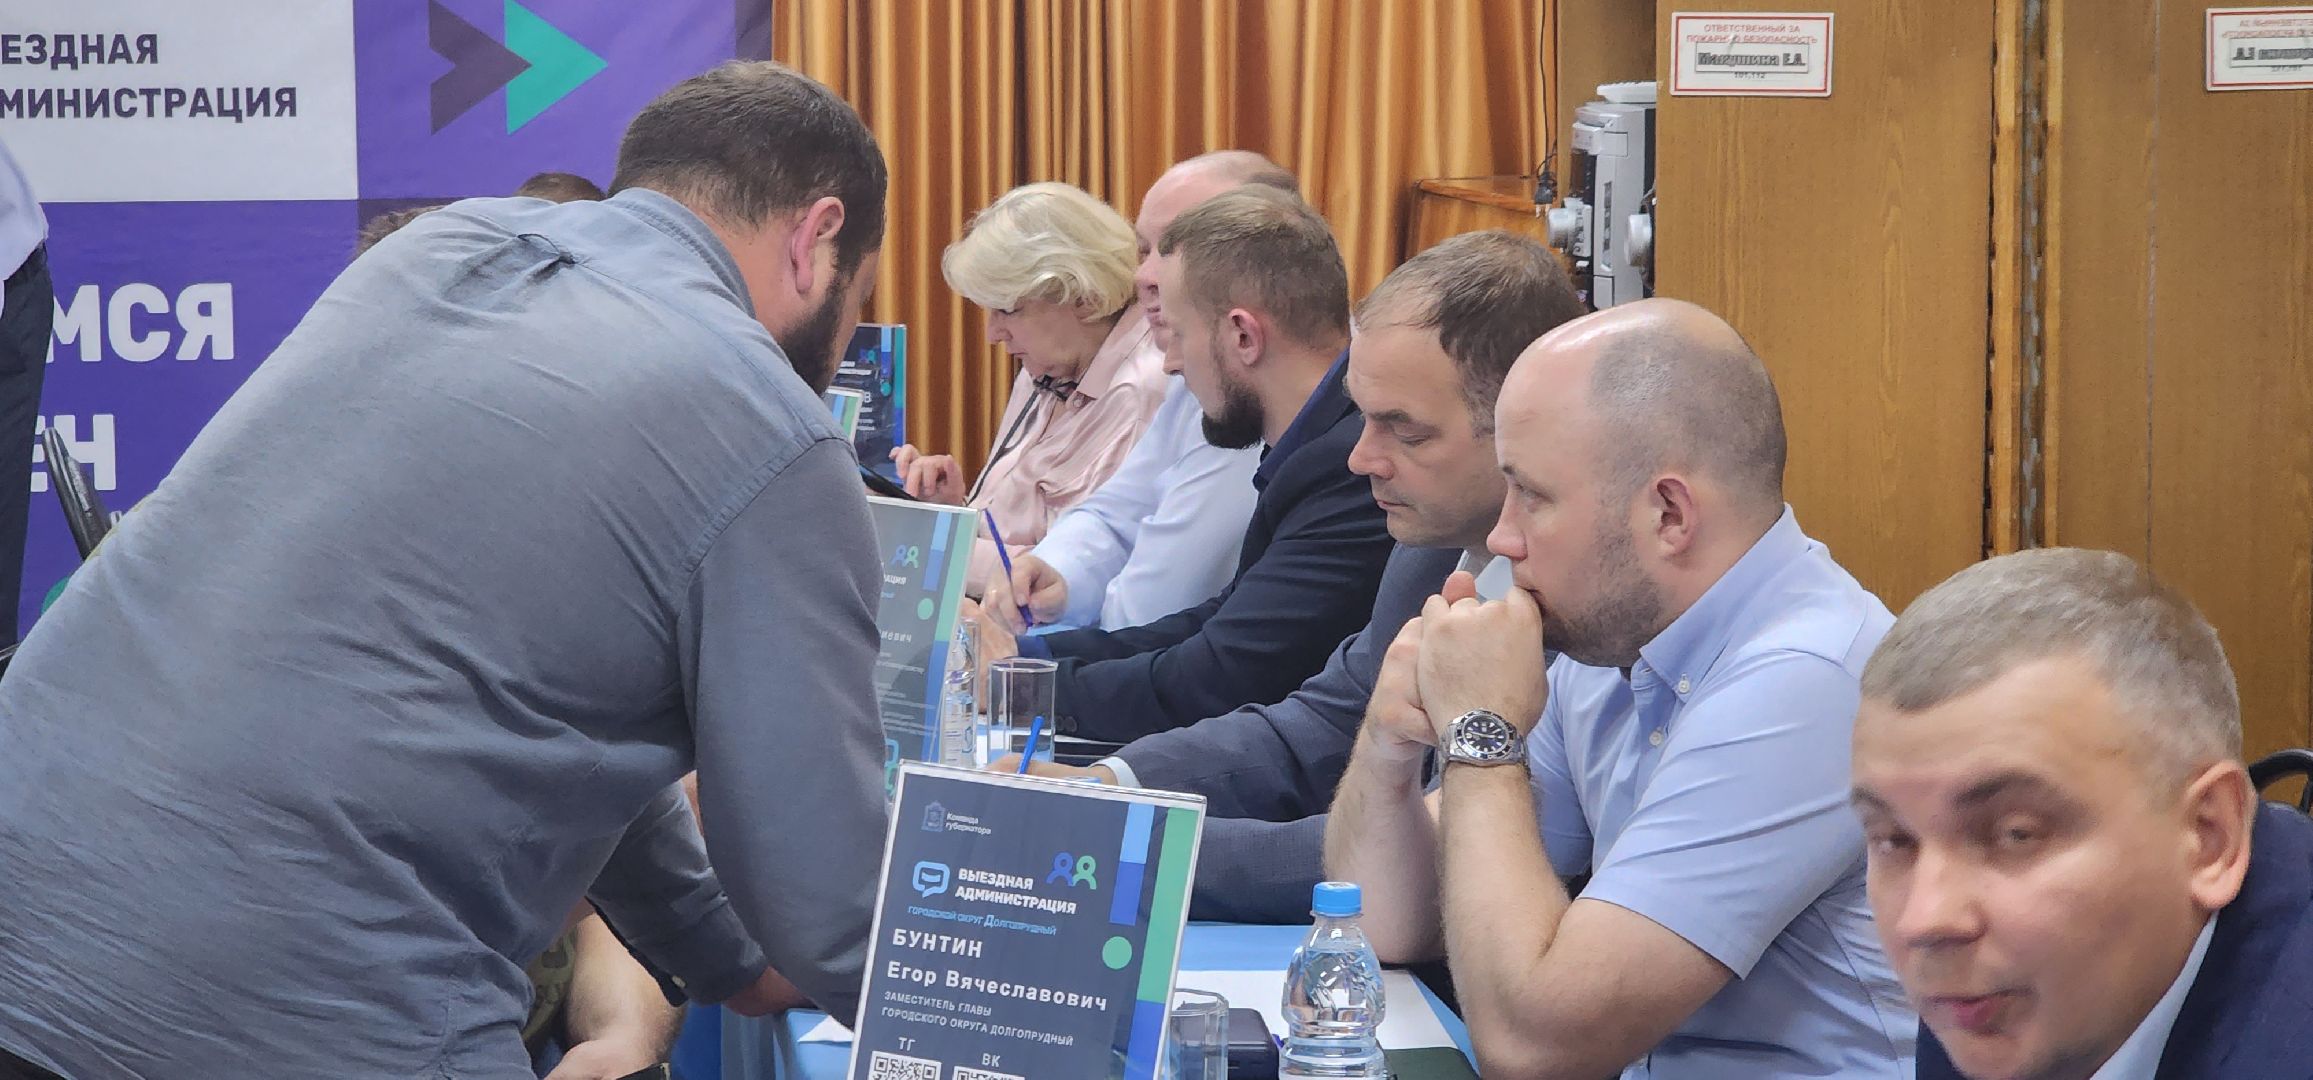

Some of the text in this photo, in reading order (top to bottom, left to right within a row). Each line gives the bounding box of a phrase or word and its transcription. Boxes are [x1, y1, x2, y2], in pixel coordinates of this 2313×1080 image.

[1, 33, 159, 70] ЕЗДНАЯ
[0, 87, 297, 124] МИНИСТРАЦИЯ
[958, 868, 1034, 890] ВЫЕЗДНАЯ
[955, 886, 1077, 915] АДМИНИСТРАЦИЯ
[892, 928, 983, 958] БУНТИН
[887, 960, 1107, 1011] Егор Вячеславович
[884, 991, 992, 1017] ЗАМЕСТИТЕЛЬ ГЛАВЫ
[881, 1006, 1074, 1046] ГОРОДСКОГО ОКРУГА ДОЛГОПРУДНЫЙ
[898, 1037, 916, 1051] ТГ
[981, 1053, 1001, 1068] ВК
